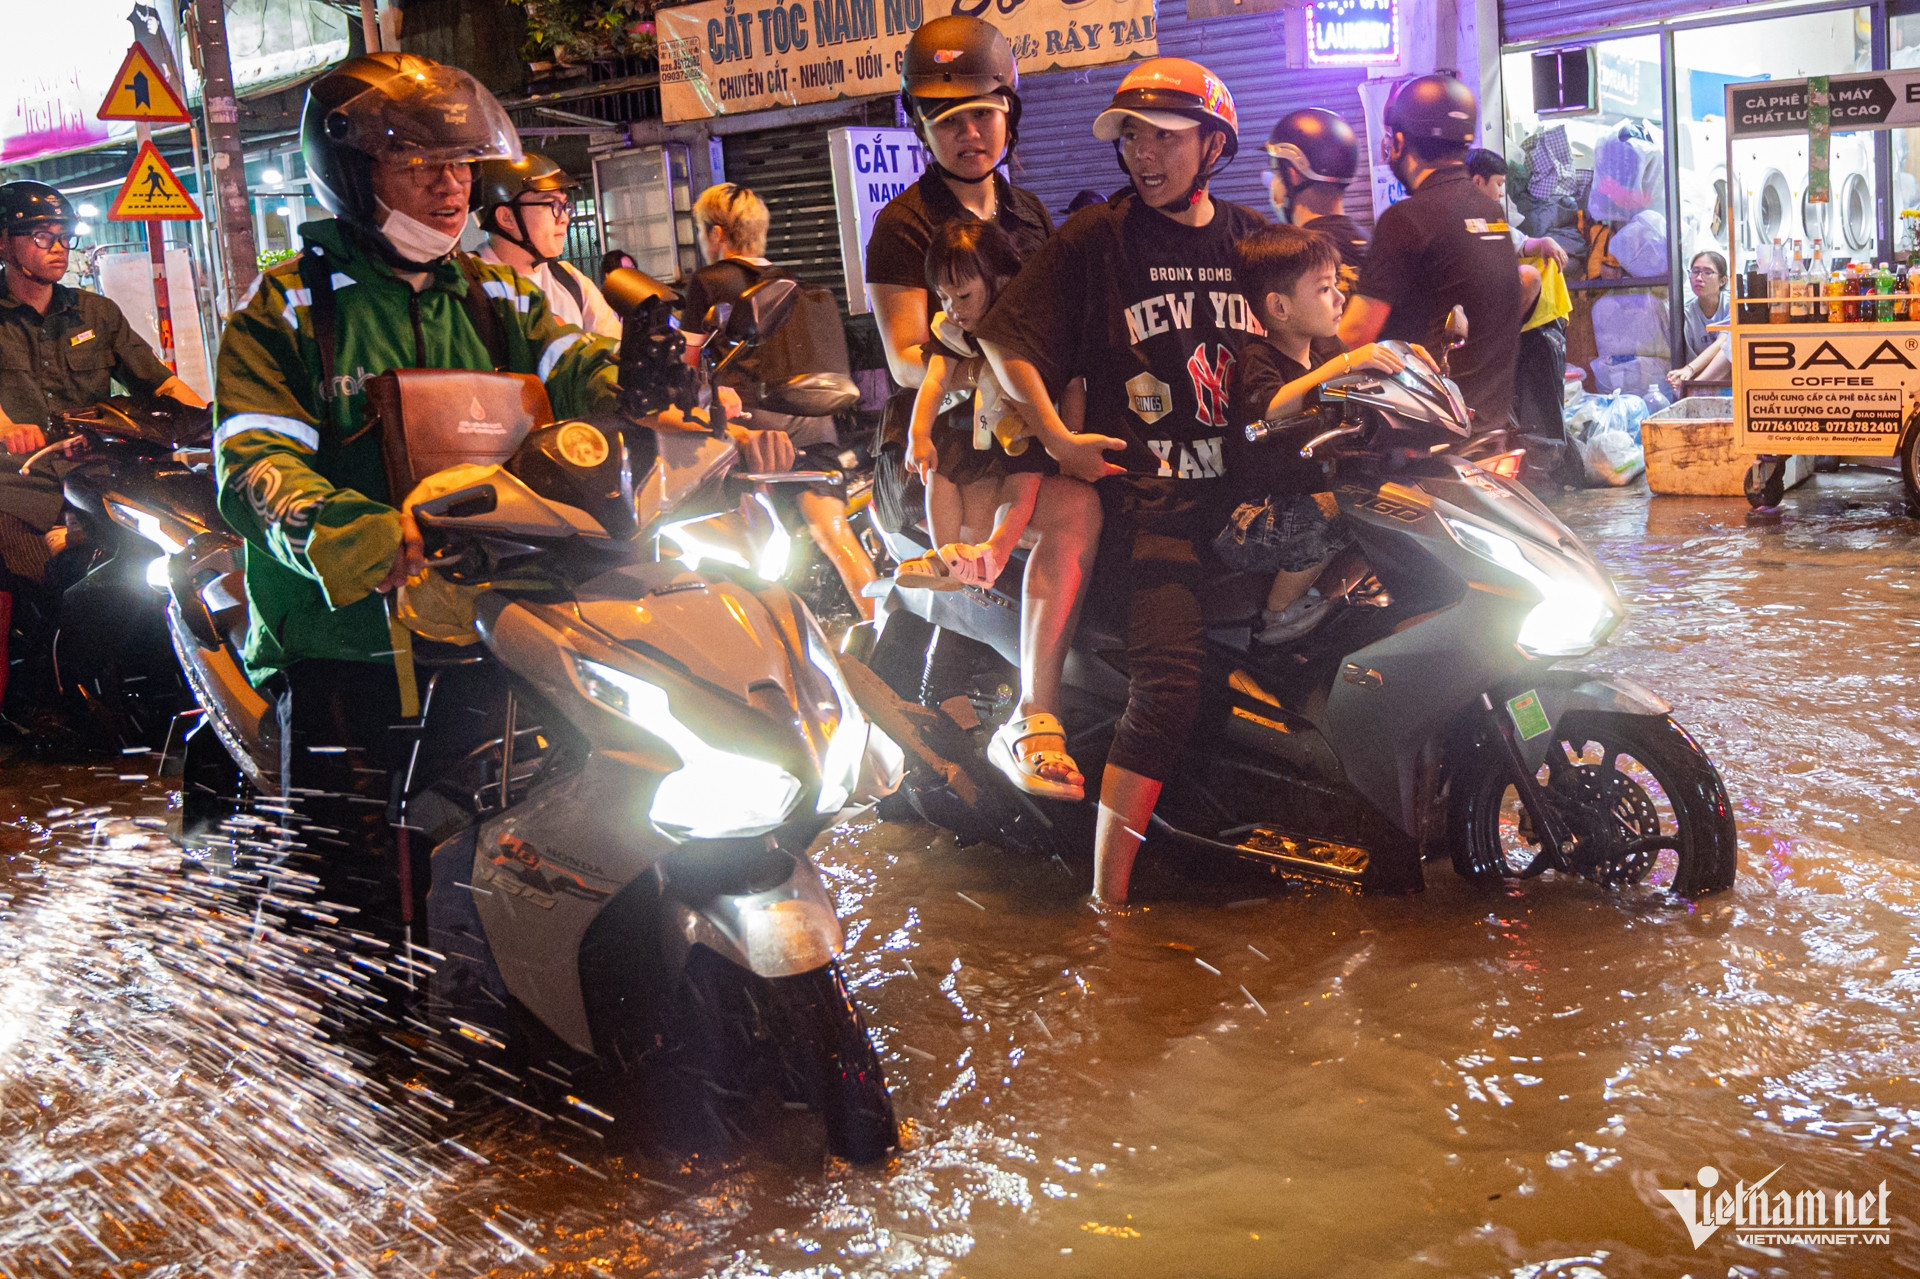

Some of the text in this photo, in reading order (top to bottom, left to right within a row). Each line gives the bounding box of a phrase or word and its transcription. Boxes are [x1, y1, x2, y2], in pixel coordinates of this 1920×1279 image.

[707, 0, 752, 64] CẮT
[758, 0, 808, 55] TÓC
[813, 0, 877, 47] NAM
[1045, 20, 1103, 55] RÁY
[1109, 15, 1156, 46] TAI
[719, 69, 763, 100] CHUYÊN
[767, 60, 788, 93] CẮT
[800, 56, 844, 90] NHUỘM
[856, 46, 882, 80] UỐN
[1745, 97, 1766, 109] CÀ
[1770, 93, 1800, 106] PHÊ
[1840, 88, 1873, 102] MÁY
[1742, 109, 1784, 124] CHẤT
[1847, 105, 1881, 116] CAO
[855, 134, 900, 173] CẮT
[1150, 268, 1193, 281] BRONX
[1124, 292, 1195, 346] NEW
[1791, 377, 1874, 386] COFFEE
[1135, 396, 1162, 411] RINGS
[1806, 392, 1823, 401] CẤP
[1825, 393, 1837, 401] CÀ
[1839, 393, 1854, 401] PHÊ
[1857, 393, 1876, 402] ĐẶC
[1878, 393, 1896, 401] SẢN
[1753, 403, 1781, 414] CHẤT
[1784, 405, 1823, 416] LƯỢNG
[1751, 421, 1819, 431] 0777661028
[1825, 421, 1898, 432] 0778782401
